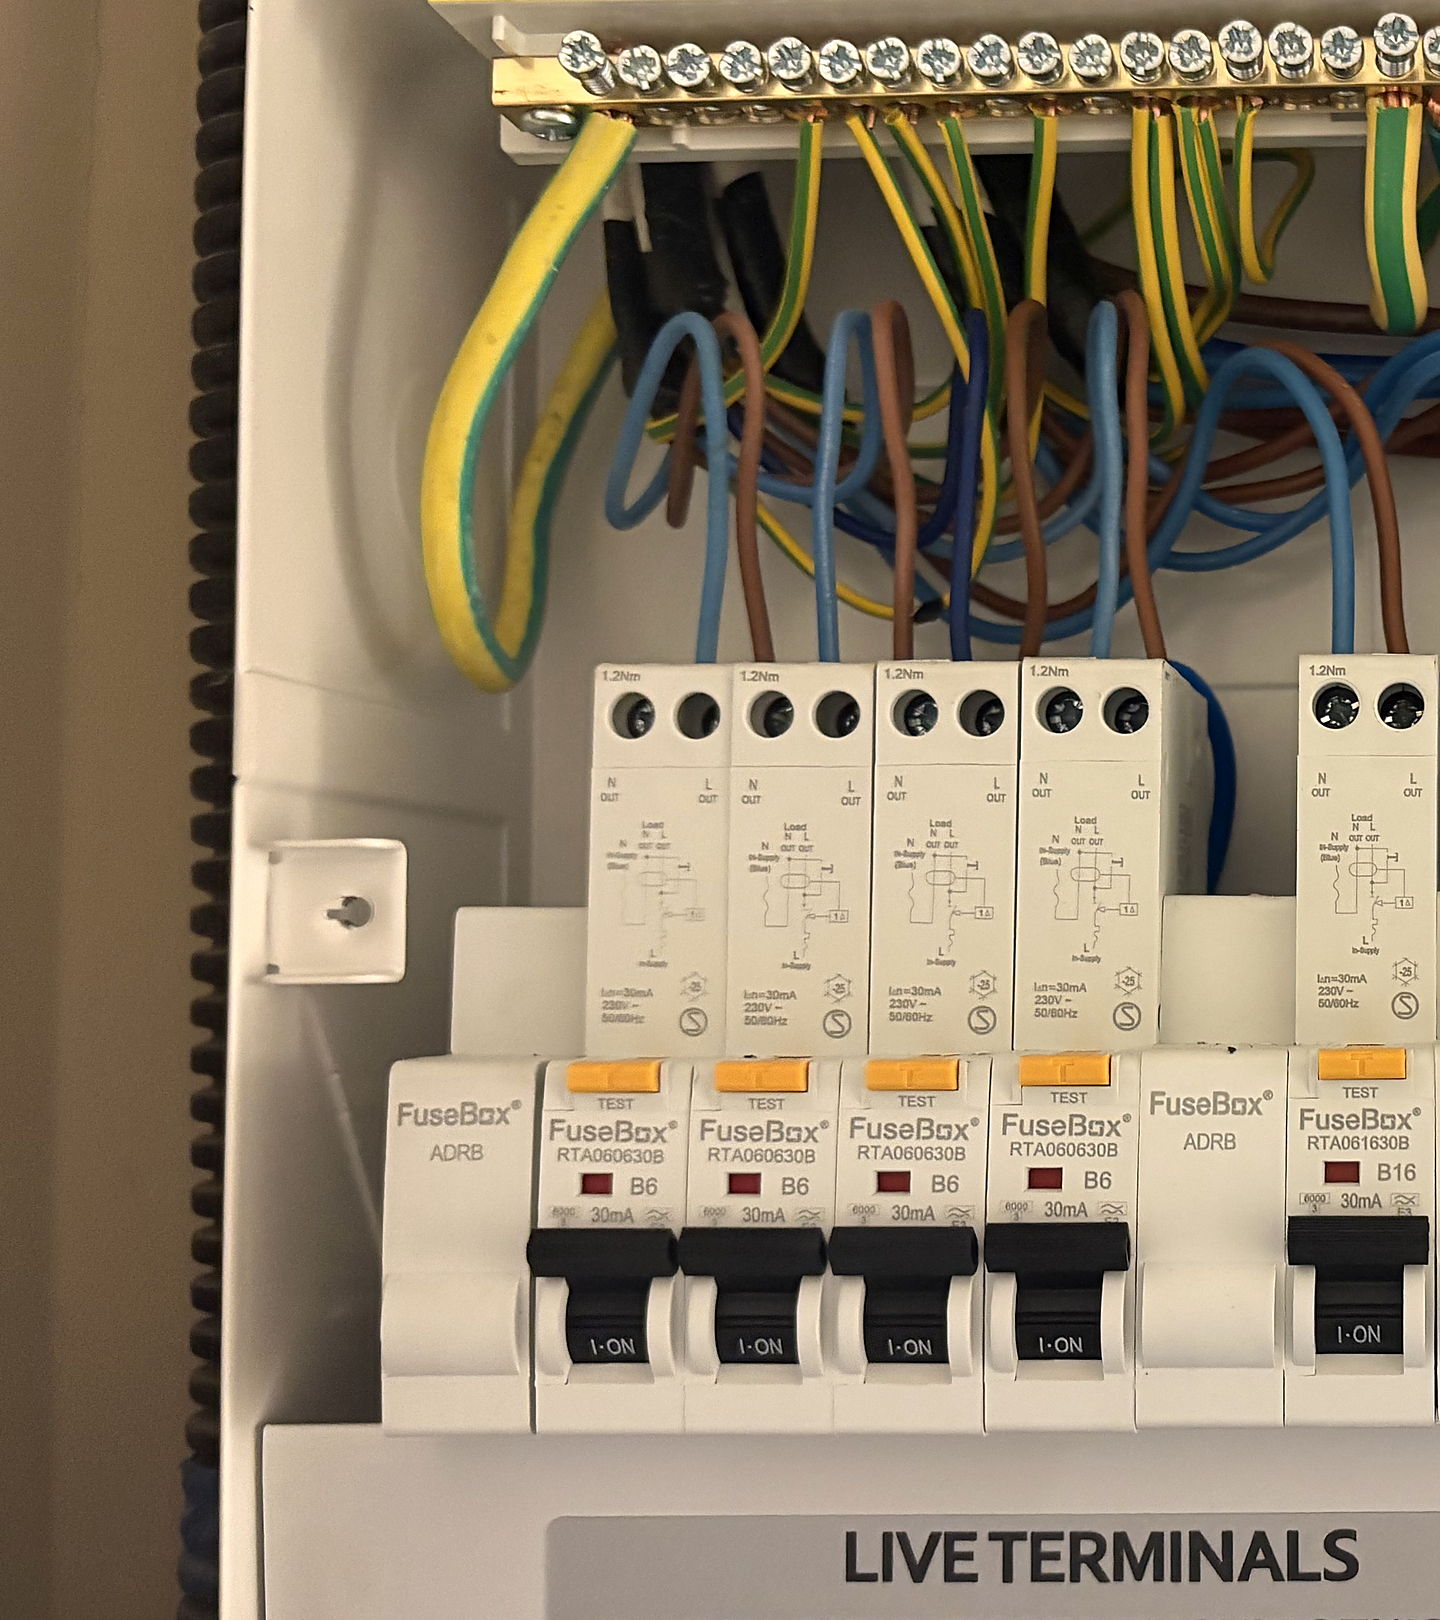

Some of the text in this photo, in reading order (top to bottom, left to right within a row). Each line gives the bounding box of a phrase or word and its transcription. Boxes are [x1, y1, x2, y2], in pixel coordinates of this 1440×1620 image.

[603, 671, 640, 682] 1.2Nm
[741, 671, 779, 682] 1.2Nm
[885, 669, 923, 680] 1.2Nm
[1030, 666, 1069, 677] 1.2Nm
[1309, 665, 1346, 677] 1.2Nm
[895, 776, 903, 787] N
[994, 777, 1000, 789] L
[1040, 773, 1048, 784] N
[1138, 775, 1144, 786] L
[1319, 773, 1326, 784] N
[1410, 773, 1416, 784] L
[887, 791, 906, 801] OUT
[987, 793, 1005, 803] OUT
[1033, 788, 1051, 798] OUT
[1131, 790, 1150, 800] OUT
[1312, 788, 1330, 797] OUT
[1404, 788, 1423, 797] OUT
[1051, 1092, 1088, 1103] TEST
[1343, 1087, 1378, 1098] TEST
[599, 1098, 633, 1110] TEST
[748, 1098, 784, 1110] TEST
[898, 1096, 936, 1107] TEST
[1184, 1133, 1236, 1150] ADRB
[1307, 1136, 1409, 1150] RTA061630B
[431, 1145, 483, 1161] ADRB
[708, 1148, 815, 1163] RTA060630B
[858, 1146, 966, 1161] RTA060630B
[1010, 1142, 1118, 1157] RTA060630B
[558, 1148, 664, 1164] RTA060630B
[1378, 1164, 1416, 1181] B16
[631, 1178, 658, 1195] B6
[782, 1178, 809, 1195] B6
[932, 1175, 959, 1193] B6
[1084, 1172, 1112, 1189] B6
[1341, 1193, 1382, 1208] 30mA
[592, 1207, 634, 1223] 30mA
[742, 1207, 785, 1223] 30mA
[892, 1205, 935, 1221] 30mA
[1044, 1201, 1088, 1217] 30mA
[845, 1530, 1360, 1583] LIVE TERMINALS
